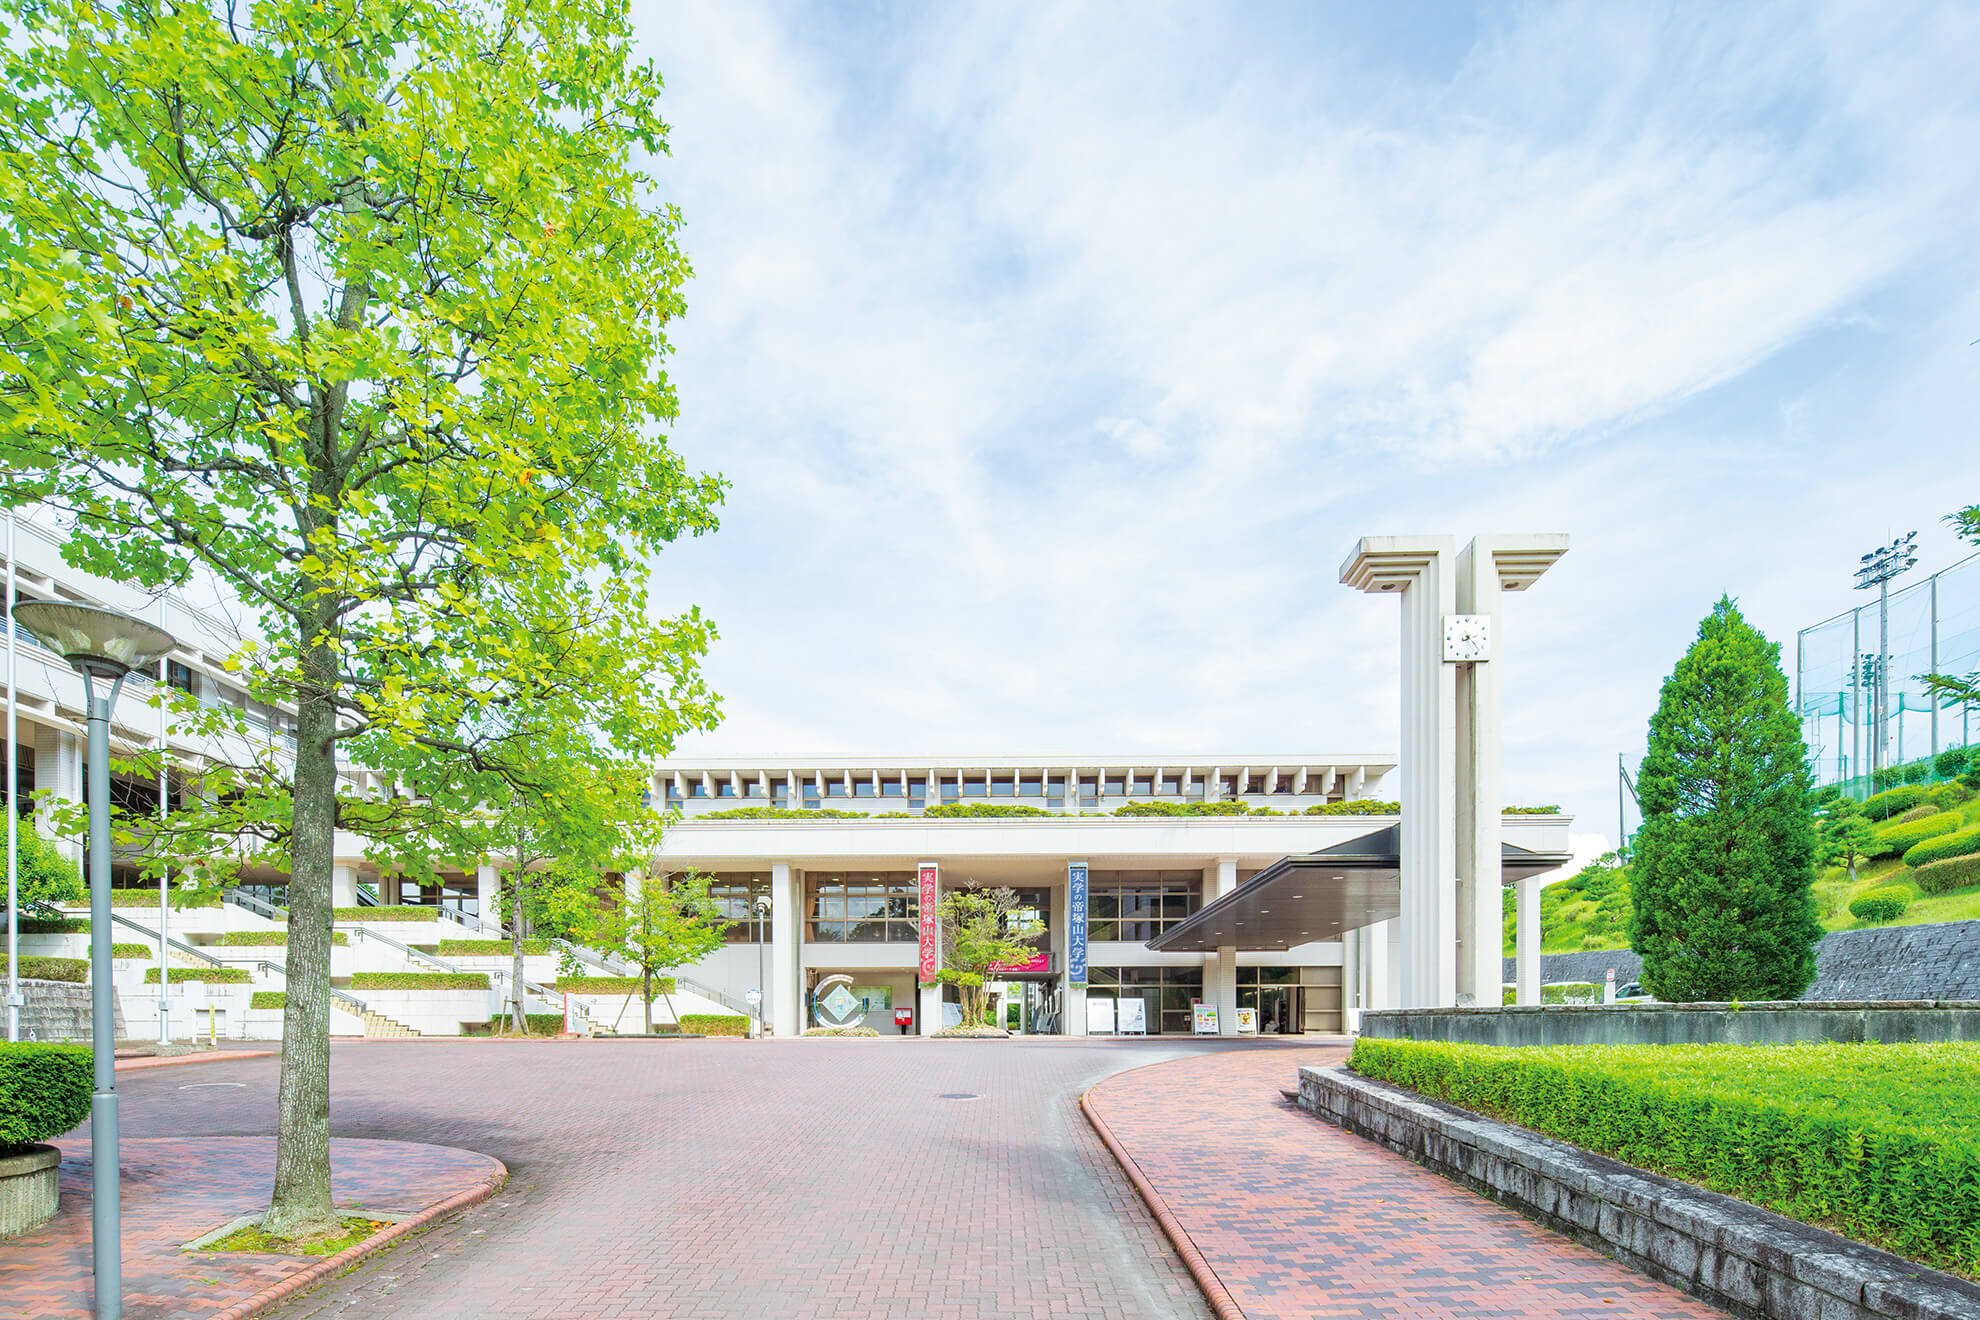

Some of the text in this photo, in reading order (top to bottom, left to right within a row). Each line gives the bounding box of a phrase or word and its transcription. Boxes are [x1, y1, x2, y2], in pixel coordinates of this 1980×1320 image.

[1072, 871, 1085, 958] 実学の帝塚山大学
